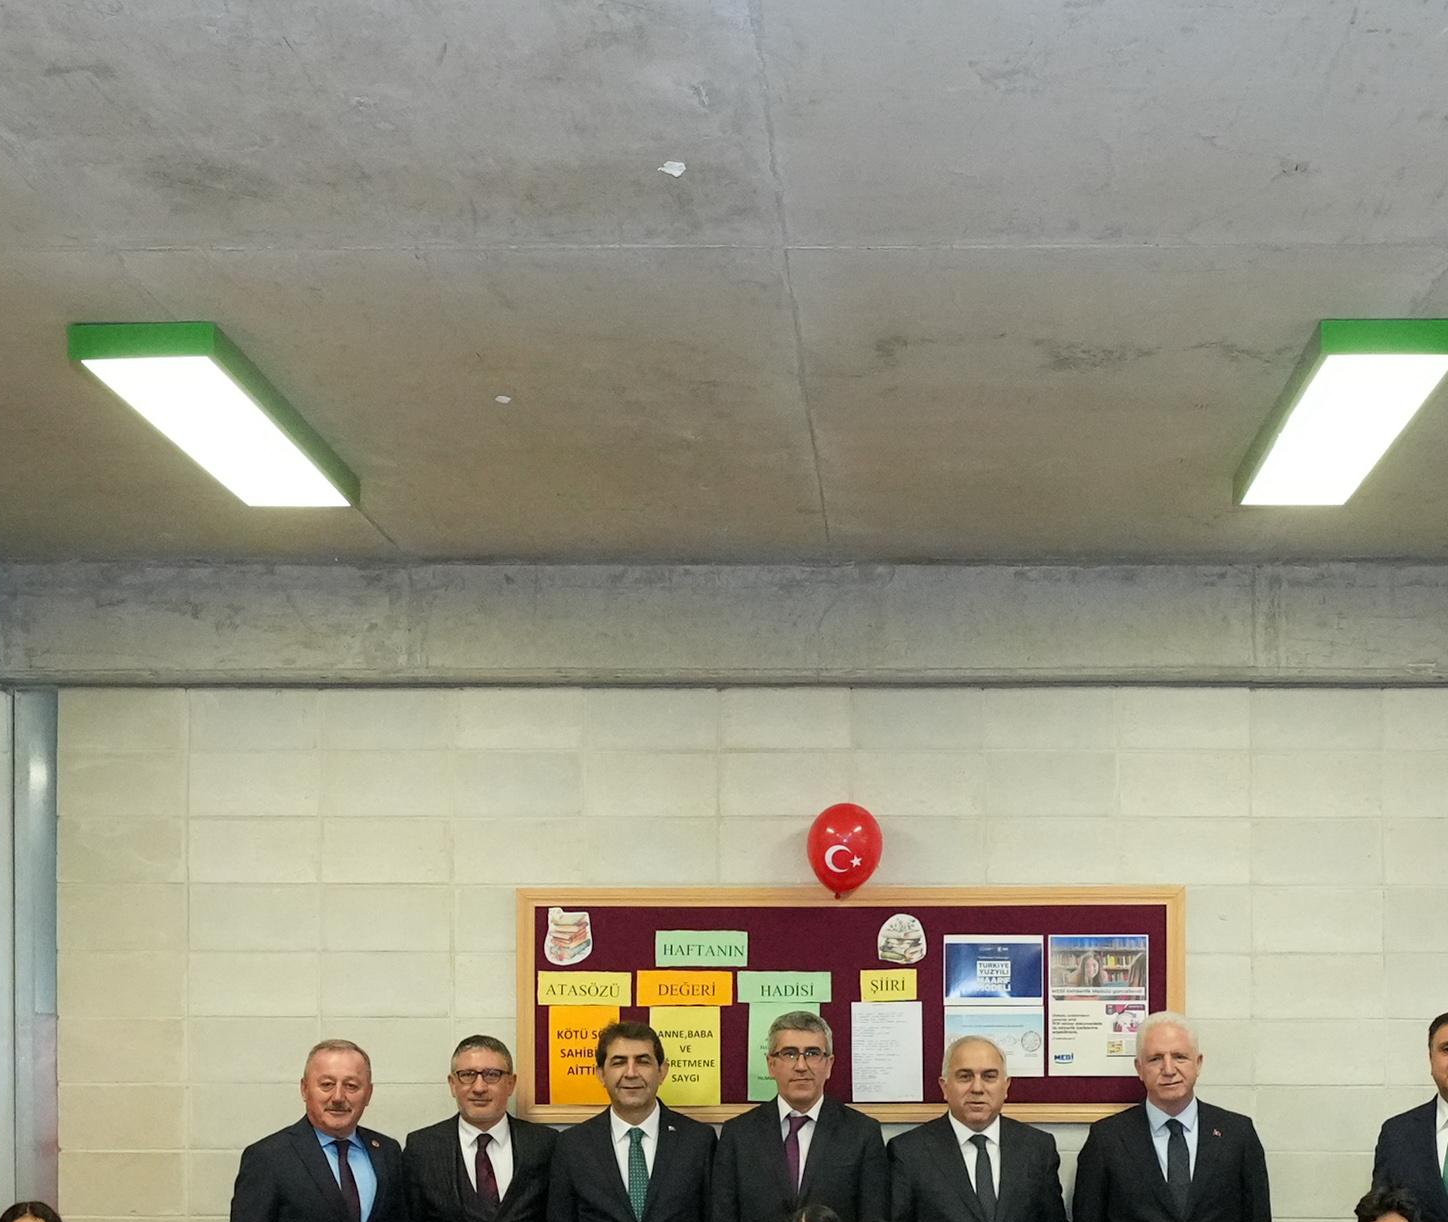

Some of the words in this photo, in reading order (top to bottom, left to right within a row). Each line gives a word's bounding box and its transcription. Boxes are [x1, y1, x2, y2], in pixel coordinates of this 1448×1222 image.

[663, 944, 745, 958] HAFTANIN
[545, 982, 621, 998] ATASÖZÜ
[658, 981, 717, 997] DEĞERİ
[760, 982, 814, 997] HADİSİ
[870, 977, 905, 994] ŞİİRİ
[557, 1027, 588, 1040] KÖTÜ
[658, 1030, 713, 1039] ANNE,BABA
[560, 1046, 597, 1058] SAHİB
[680, 1044, 693, 1053] VE
[666, 1057, 715, 1068] RETMENE
[567, 1064, 596, 1075] AİTTİ
[671, 1074, 699, 1083] SAYGI
